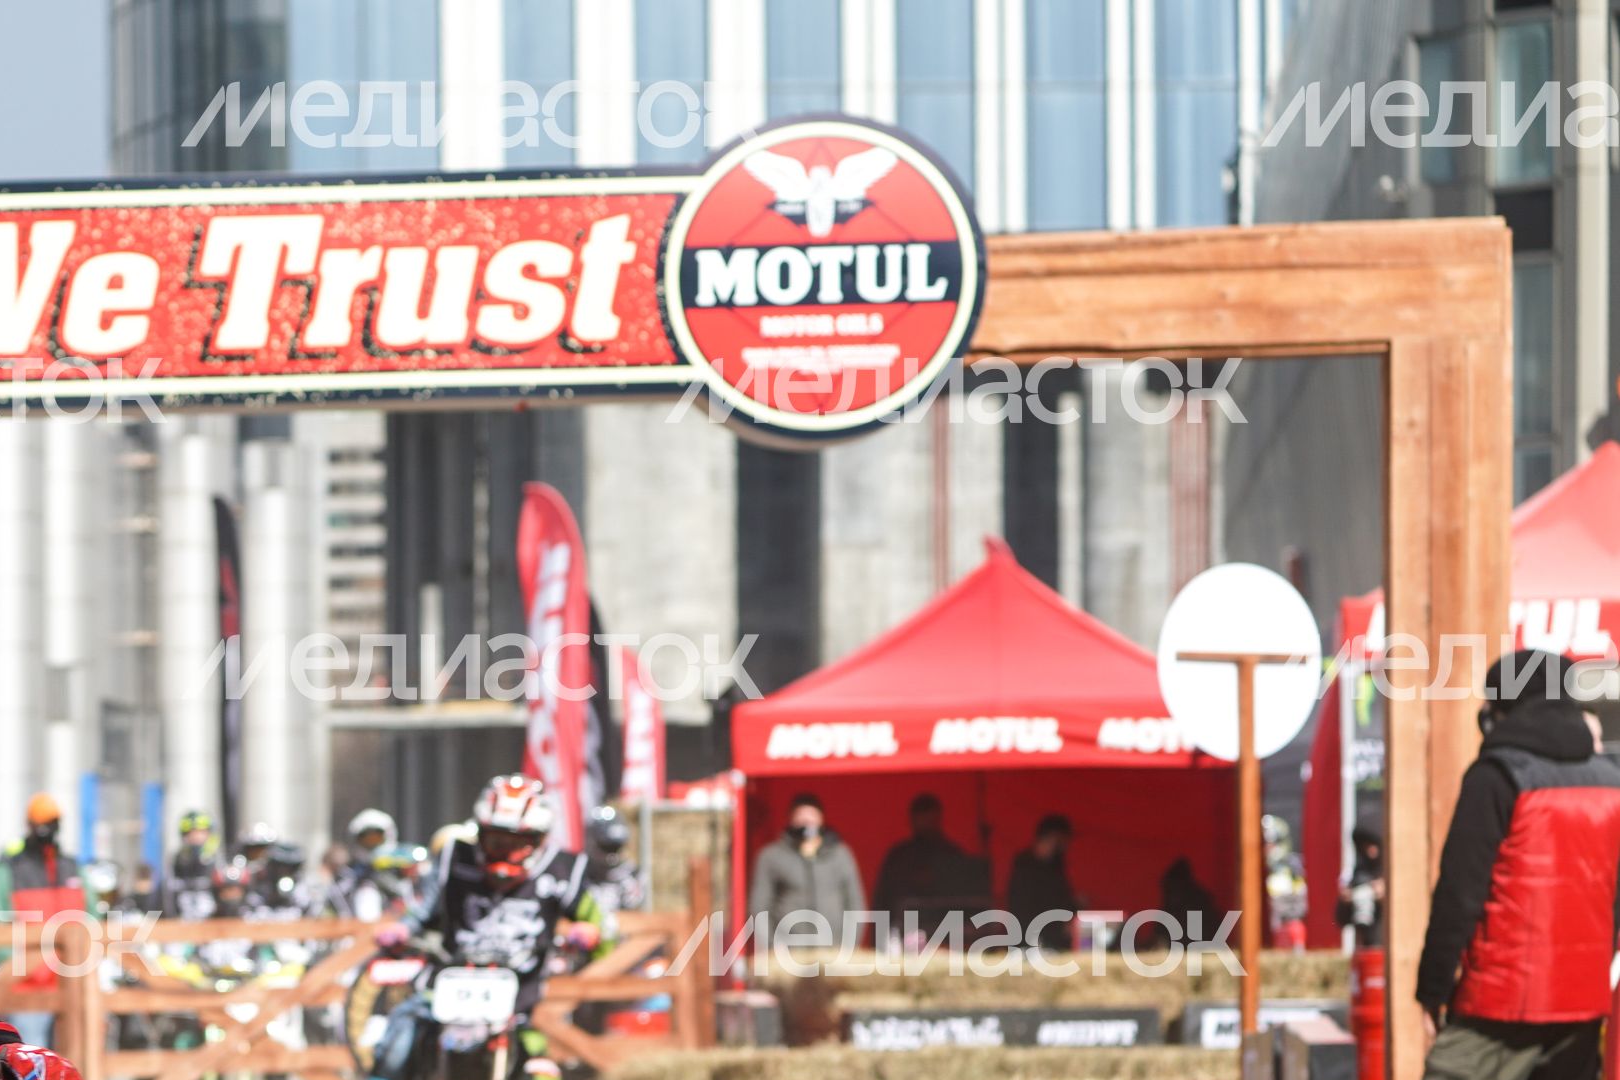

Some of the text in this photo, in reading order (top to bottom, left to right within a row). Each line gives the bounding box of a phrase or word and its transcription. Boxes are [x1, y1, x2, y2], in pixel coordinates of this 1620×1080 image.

[199, 213, 637, 351] Trust
[695, 244, 948, 306] MOTUL
[765, 722, 899, 760] MOTUL
[928, 716, 1064, 754] MOTUL
